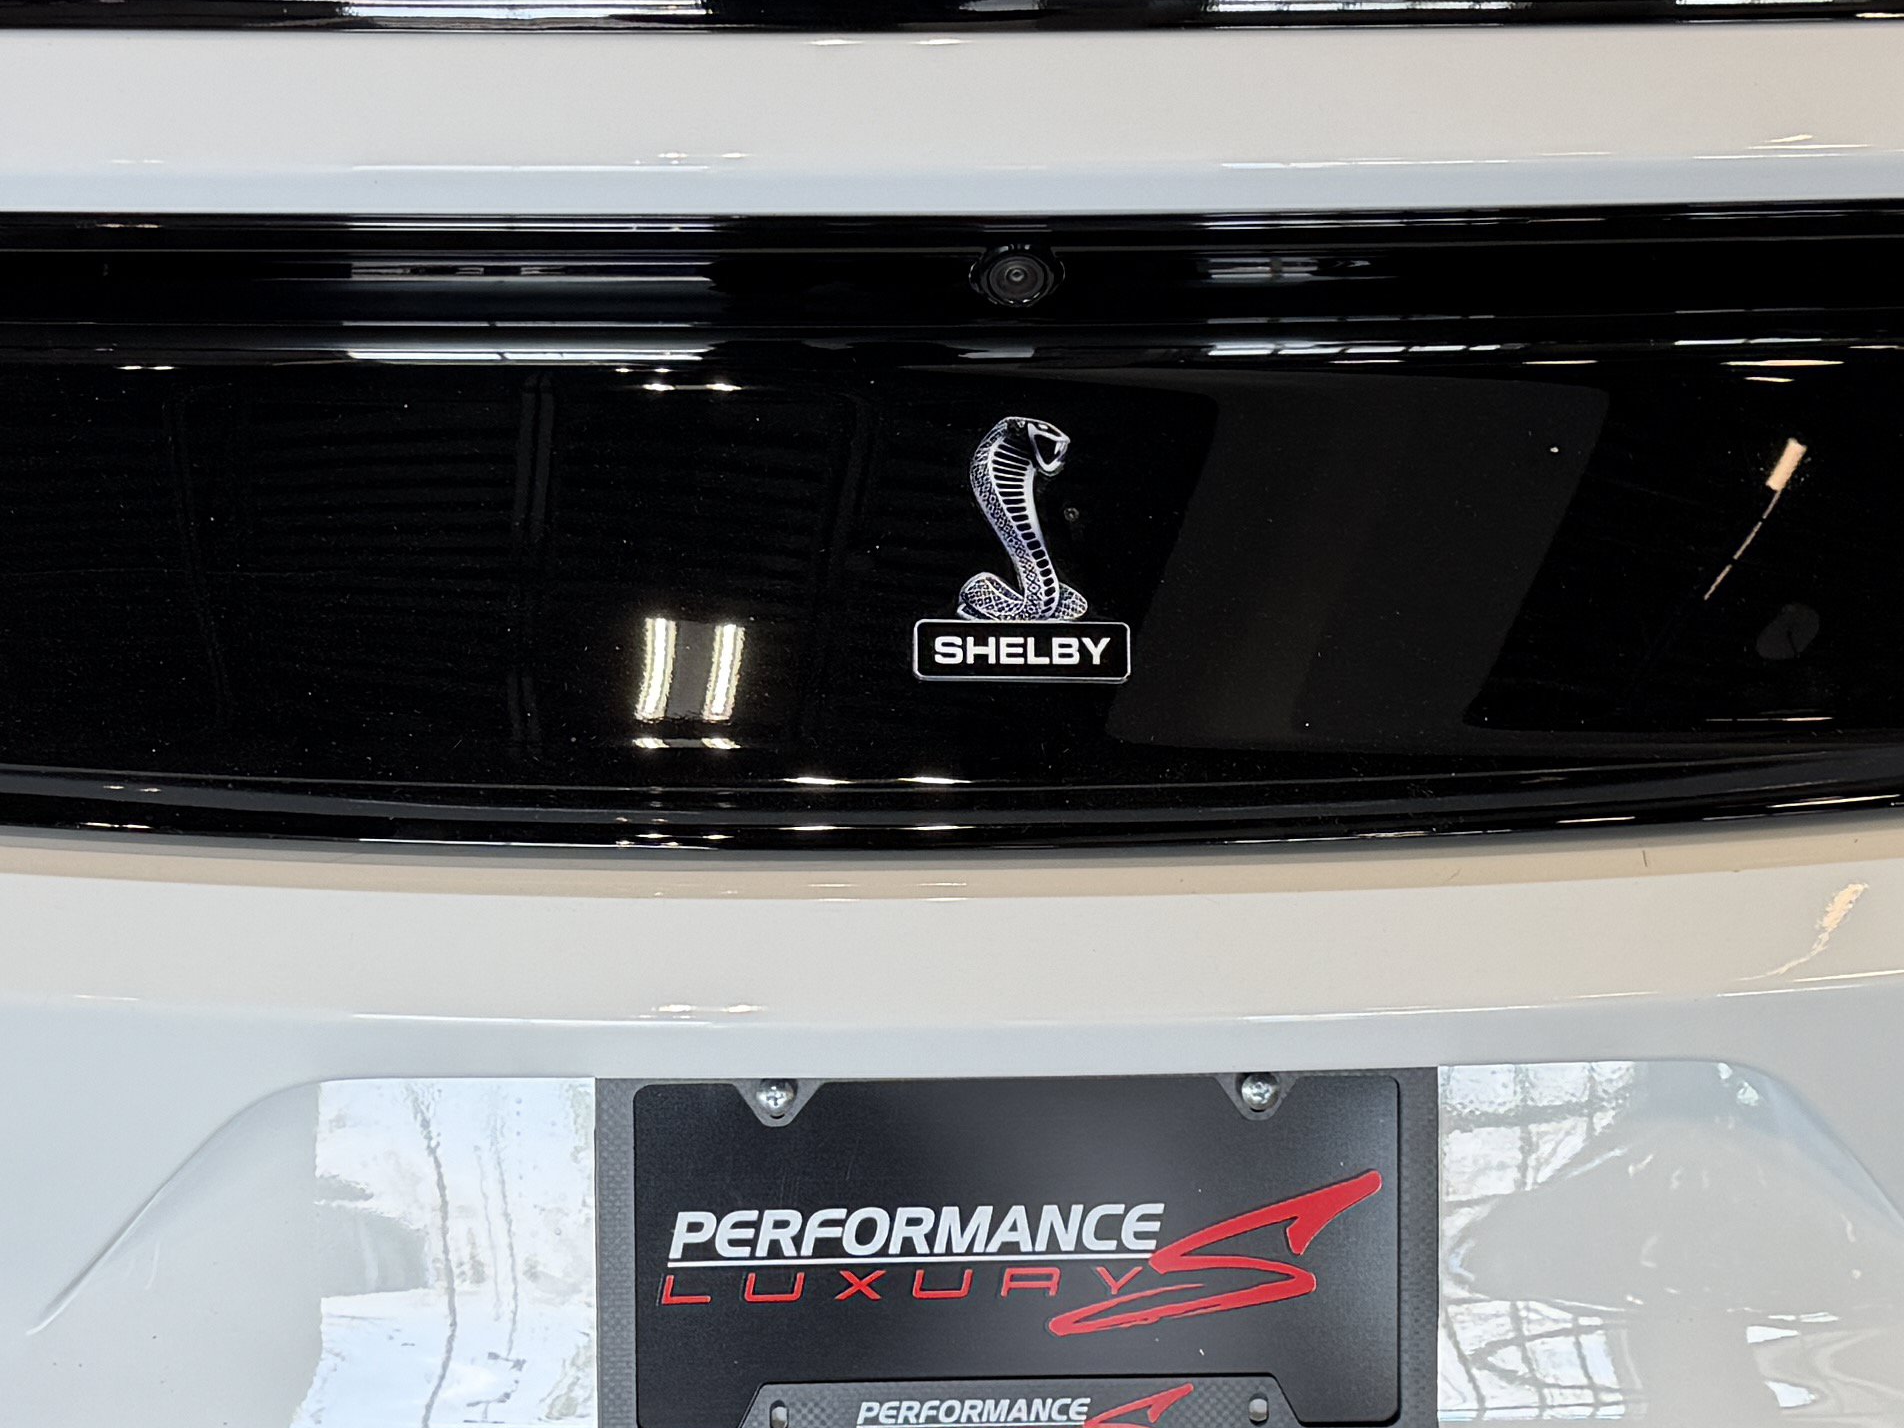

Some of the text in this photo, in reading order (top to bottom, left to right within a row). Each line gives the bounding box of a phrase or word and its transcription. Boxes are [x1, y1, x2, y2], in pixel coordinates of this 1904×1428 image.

[933, 635, 1111, 665] SHELBY
[668, 1203, 1165, 1260] PERFORMANCE
[660, 1266, 1144, 1305] LUXURY
[856, 1397, 1091, 1425] PERFORMANCE
